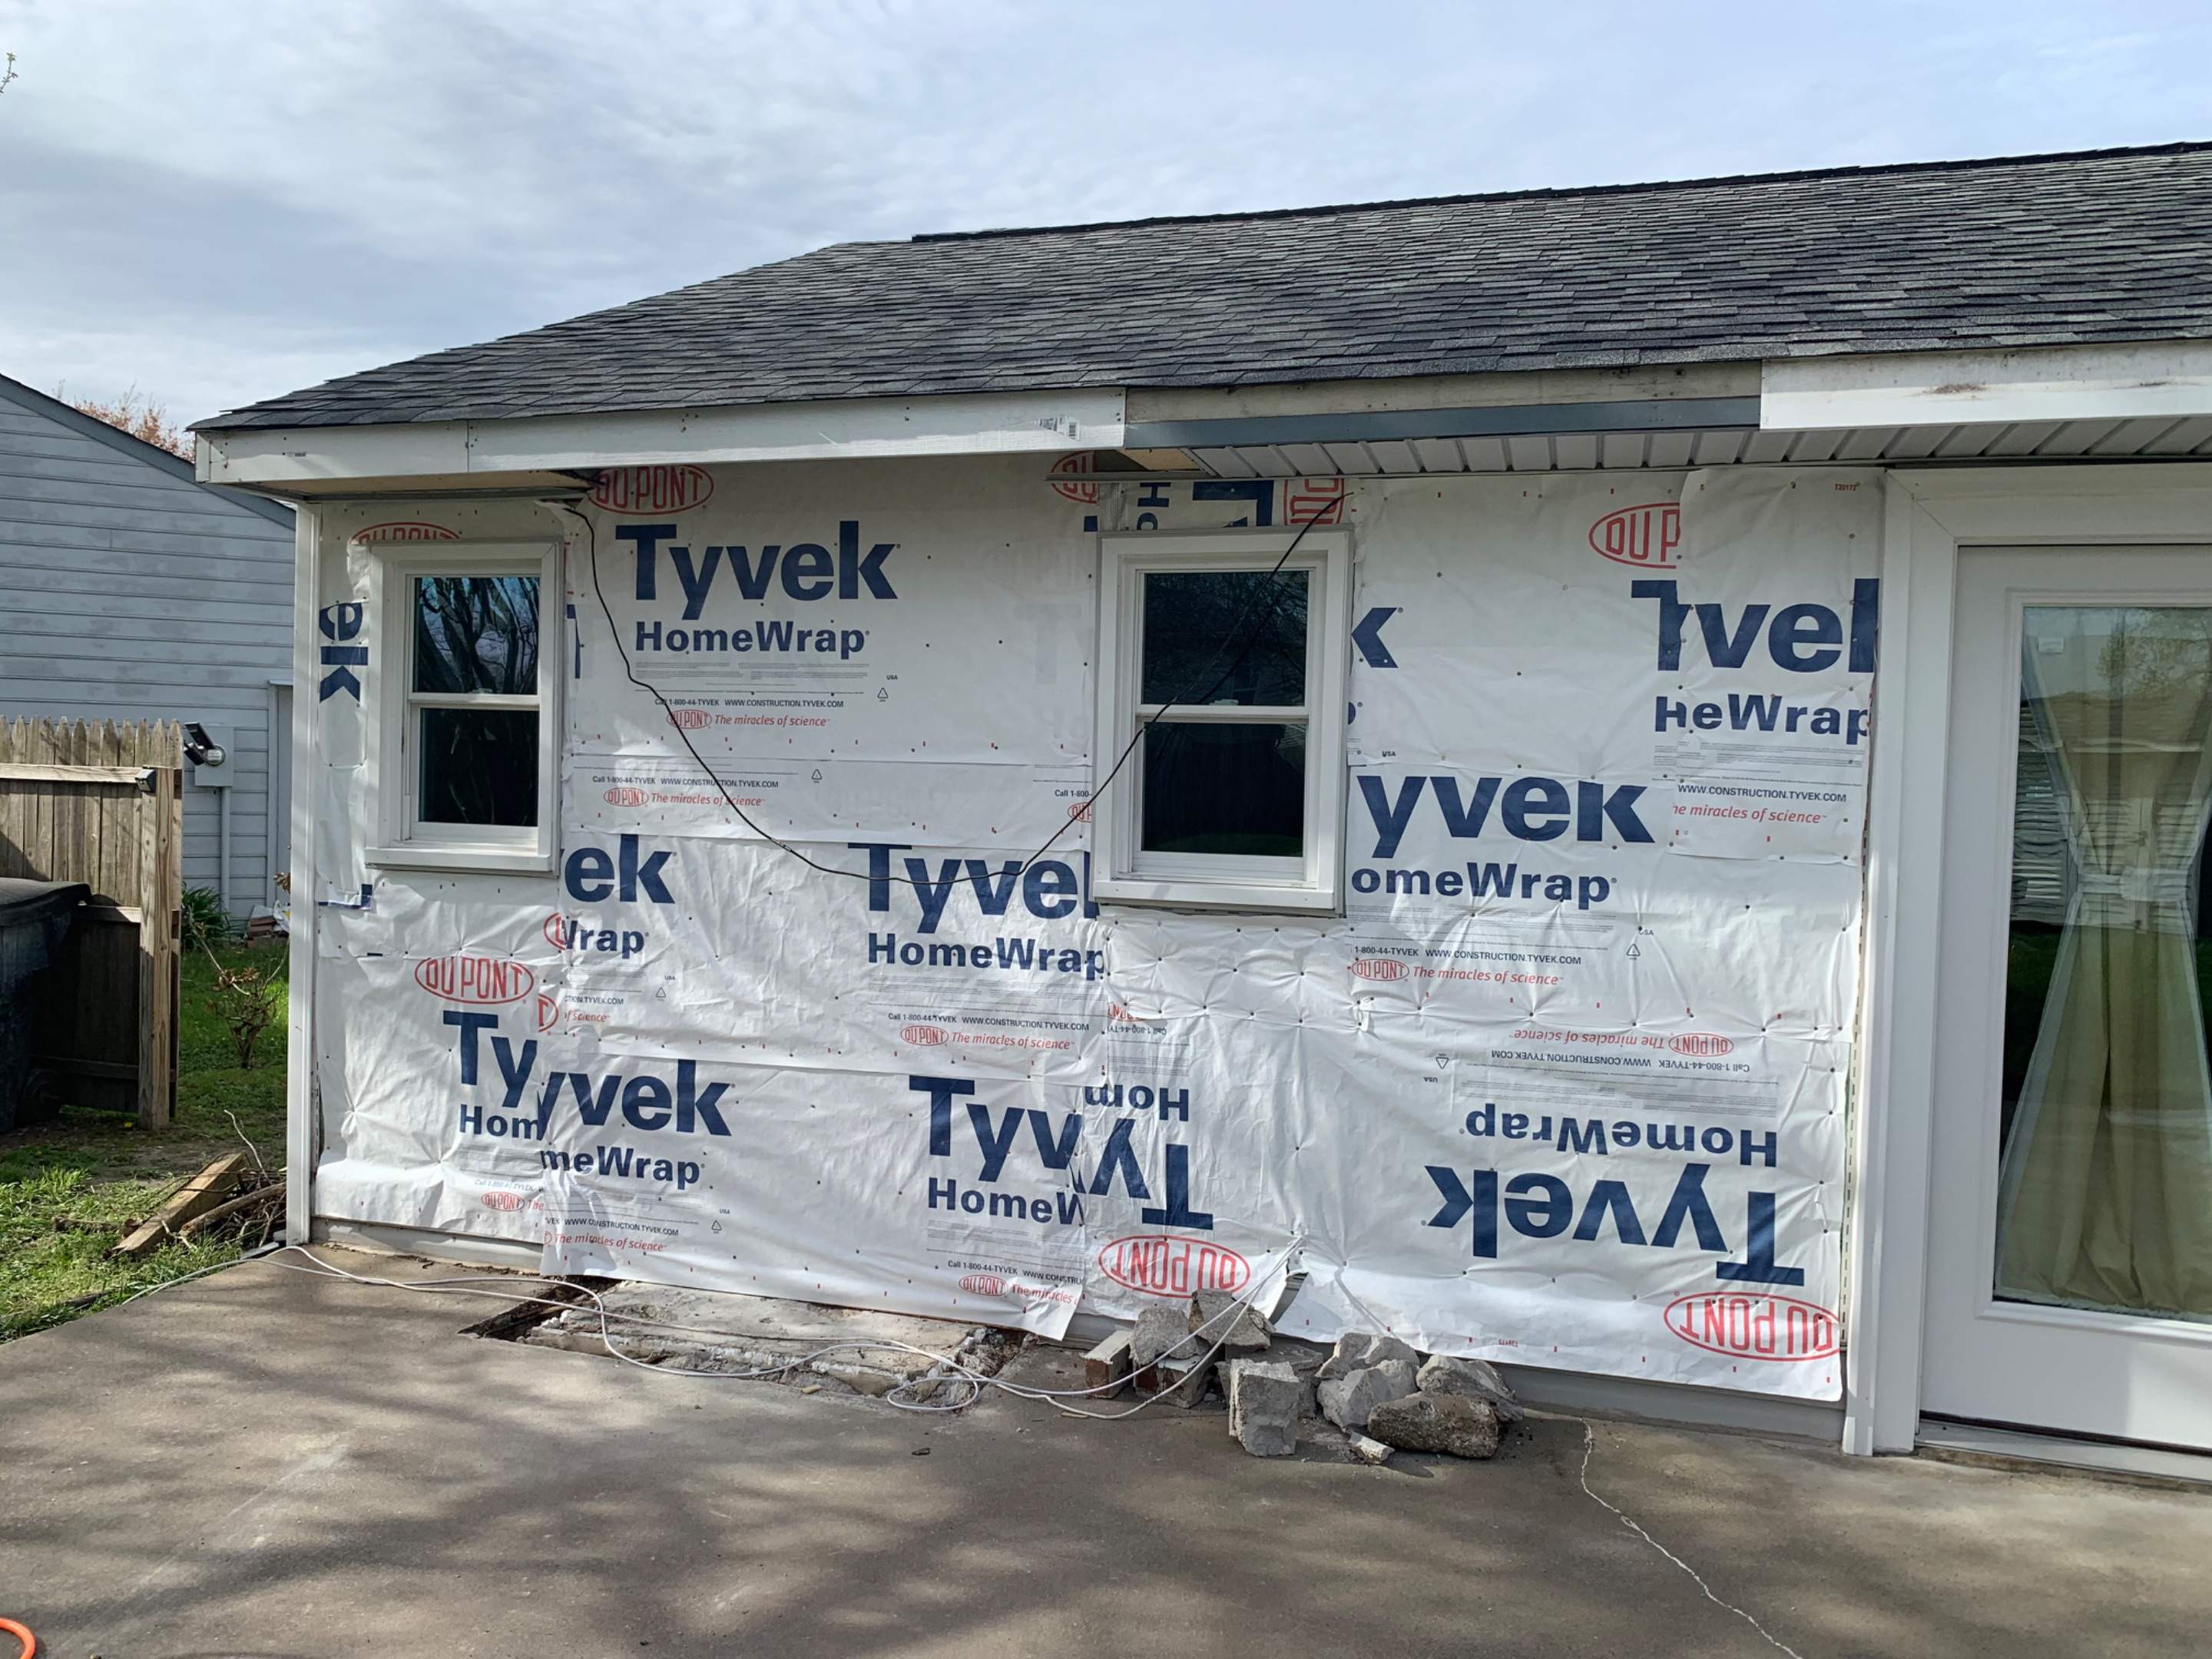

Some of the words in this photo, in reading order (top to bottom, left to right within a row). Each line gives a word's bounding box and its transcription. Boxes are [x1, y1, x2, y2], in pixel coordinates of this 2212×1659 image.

[615, 520, 899, 621] Tyvek
[635, 621, 866, 661] HomeWrap
[724, 699, 844, 708] WWW.CONSTRUCTION.TYVEK.COM
[714, 714, 732, 726] The
[734, 714, 775, 726] miracles
[777, 715, 789, 728] of
[790, 716, 827, 727] science
[592, 775, 605, 783] Call
[607, 776, 656, 784] 1-800-44-TYVEK
[661, 777, 779, 789] WWW.CONSTRUTION.TYVEK.COM
[651, 793, 669, 803] The
[671, 793, 710, 805] miracles
[713, 795, 724, 806] of
[725, 796, 762, 806] science
[1054, 789, 1068, 797] Call
[1677, 783, 1846, 802] WWW.CONSTRUCTION.TYVEK.COM
[1356, 775, 1655, 859] yvek
[1690, 804, 1748, 819] miracles
[1751, 808, 1768, 823] of
[1768, 810, 1822, 823] science
[1351, 862, 1611, 911] omeWrap
[868, 932, 1104, 982] HomeWrap
[1355, 945, 1419, 957] 1-800-44-TYVEK
[1425, 949, 1581, 965] WWW.CONSTRUCTION.TYVEK.COM
[425, 957, 525, 999] DUPONT
[1356, 961, 1406, 979] DUPONT
[1412, 966, 1435, 978] The
[1438, 968, 1491, 981] miracles
[1495, 970, 1509, 985] of
[1510, 972, 1559, 985] science
[572, 1011, 608, 1023] science
[888, 1012, 901, 1021] Call
[902, 1013, 957, 1023] 1-800-44-TYVEK
[962, 1016, 1090, 1031] WWW.CONSTRUCTION.TYVEK.COM
[905, 1027, 945, 1044] DUPONT
[952, 1031, 970, 1043] The
[972, 1031, 1015, 1046] miracles
[1018, 1035, 1029, 1049] of
[1030, 1038, 1071, 1050] science
[1513, 1029, 1563, 1043] science
[1563, 1030, 1578, 1045] of
[1581, 1032, 1637, 1047] miracles
[1641, 1037, 1664, 1049] The
[1674, 1035, 1729, 1055] DUPONT
[1491, 1050, 1651, 1067] WWW.CONSTRUCTION.TYVEK.COM
[1658, 1059, 1730, 1071] 1-800-44-TYVEK
[1733, 1064, 1750, 1073] Call
[1465, 1102, 1777, 1167] HomeWrap
[527, 1199, 545, 1211] The
[1423, 1161, 1805, 1286] Tyvek
[555, 1233, 572, 1244] The
[575, 1232, 614, 1247] miracles
[616, 1237, 628, 1250] of
[628, 1239, 664, 1252] science
[948, 1260, 960, 1268] Call
[962, 1261, 1018, 1276] 1-800-44-TYVEK
[1112, 1240, 1236, 1294] DUPONT
[962, 1276, 1006, 1296] DUPONT
[1011, 1283, 1030, 1296] The
[1031, 1289, 1073, 1304] miracles
[1679, 1296, 1833, 1356] DUPONT
